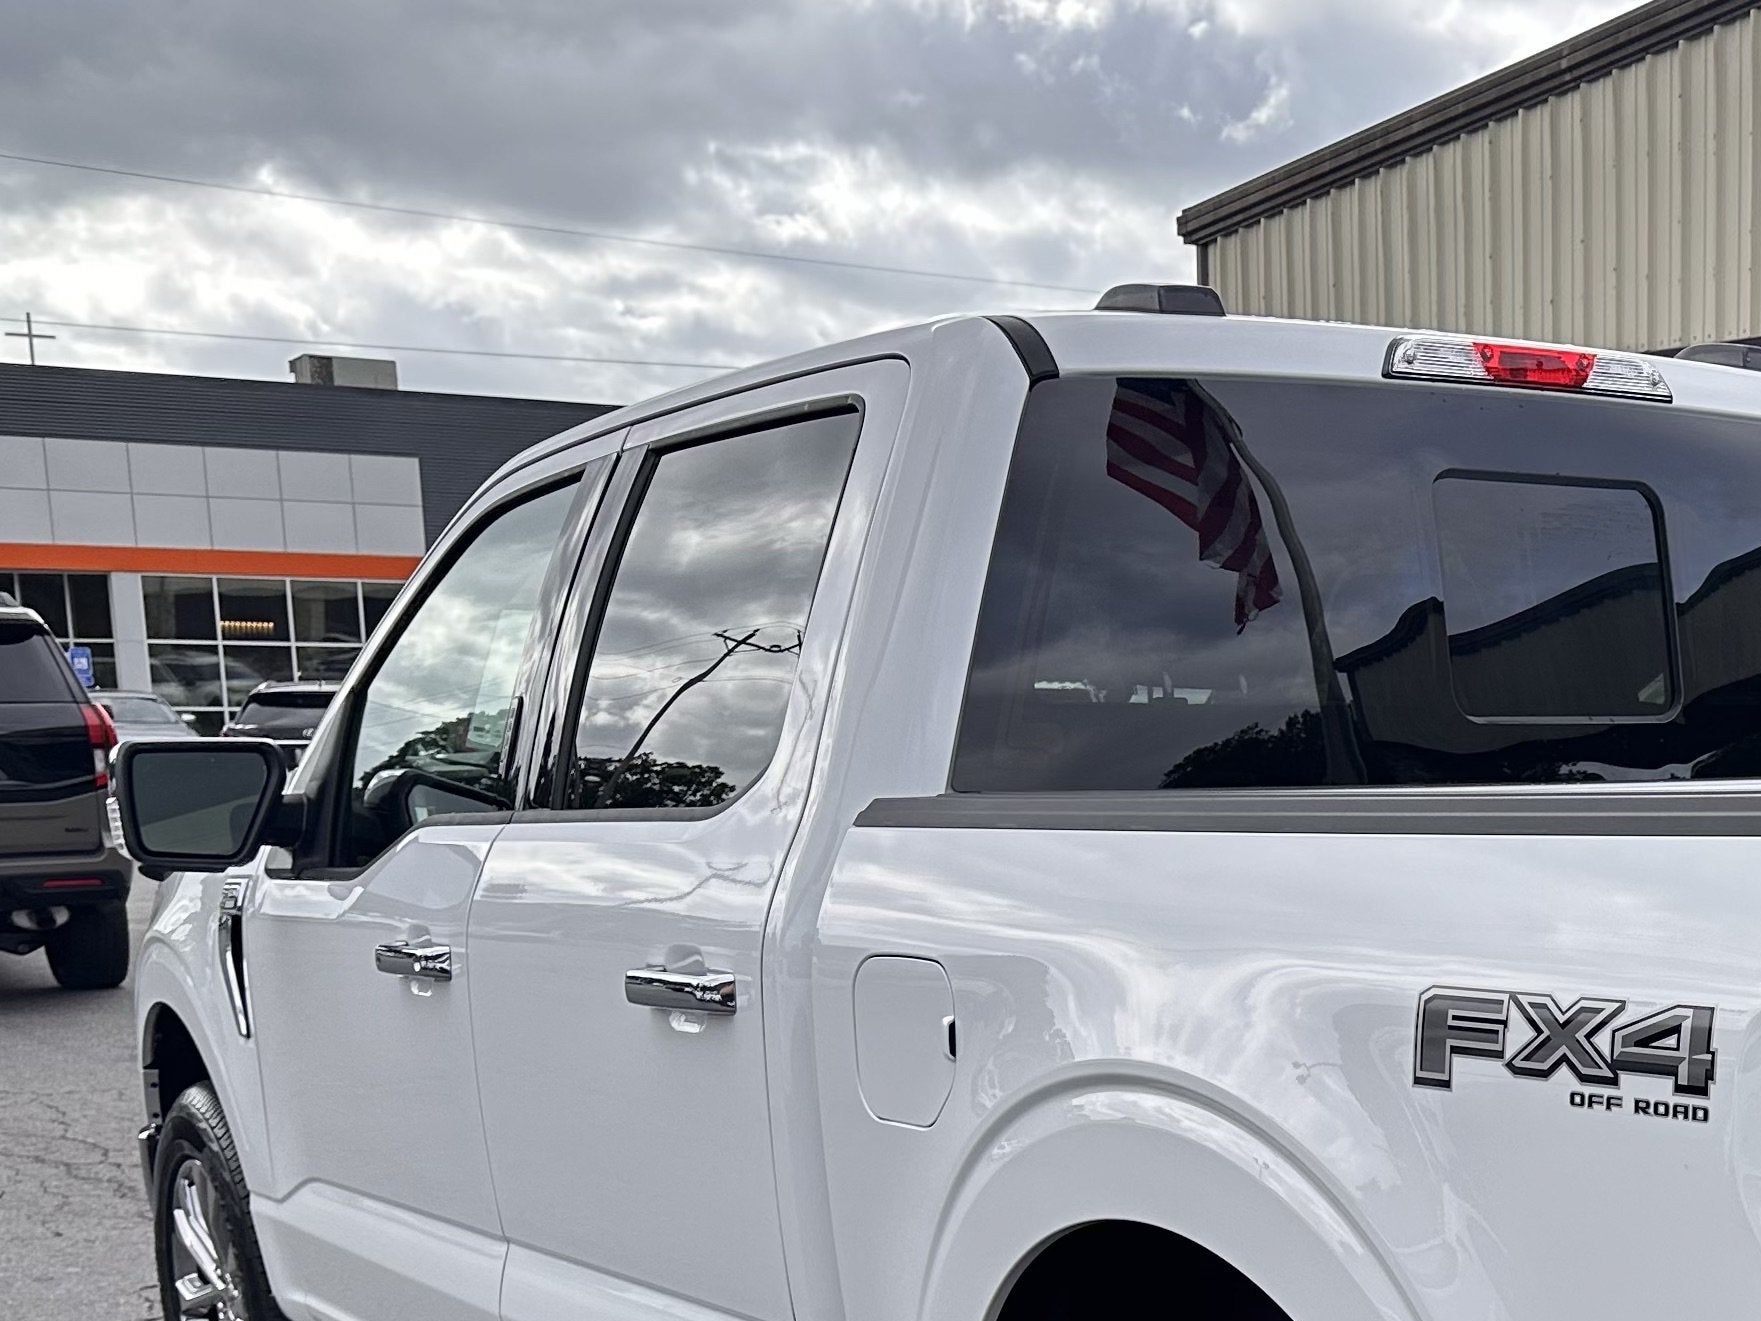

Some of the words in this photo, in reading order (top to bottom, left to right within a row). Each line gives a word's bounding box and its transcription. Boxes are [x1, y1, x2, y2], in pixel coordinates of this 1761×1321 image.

[1412, 985, 1718, 1099] FX4
[1569, 1090, 1624, 1111] OFF
[1634, 1097, 1710, 1124] ROAD
